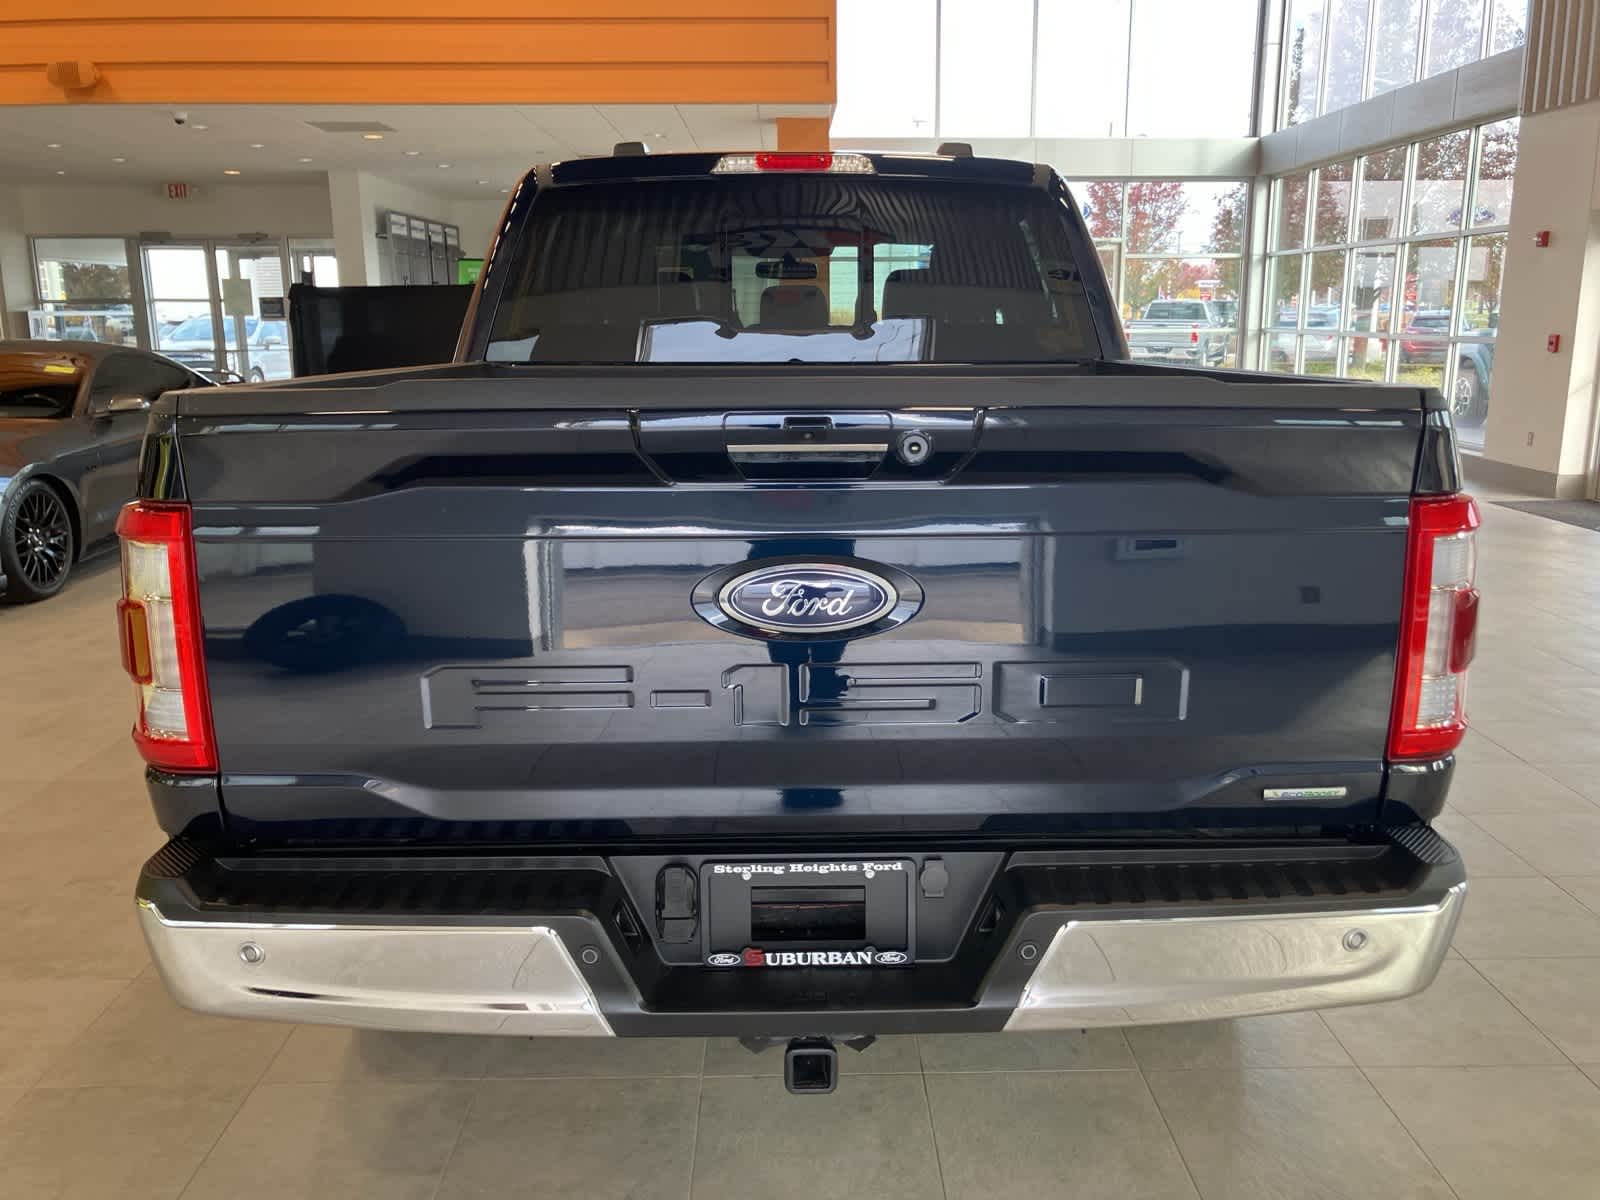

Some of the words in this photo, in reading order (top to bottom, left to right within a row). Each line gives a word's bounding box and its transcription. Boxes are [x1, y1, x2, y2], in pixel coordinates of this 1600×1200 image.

[168, 183, 188, 199] EXIT
[761, 578, 853, 617] Ford
[420, 661, 1191, 729] F-150
[713, 863, 785, 875] Sterling
[789, 863, 858, 874] Heights
[863, 862, 903, 872] Ford
[744, 949, 873, 966] SUBURBAN
